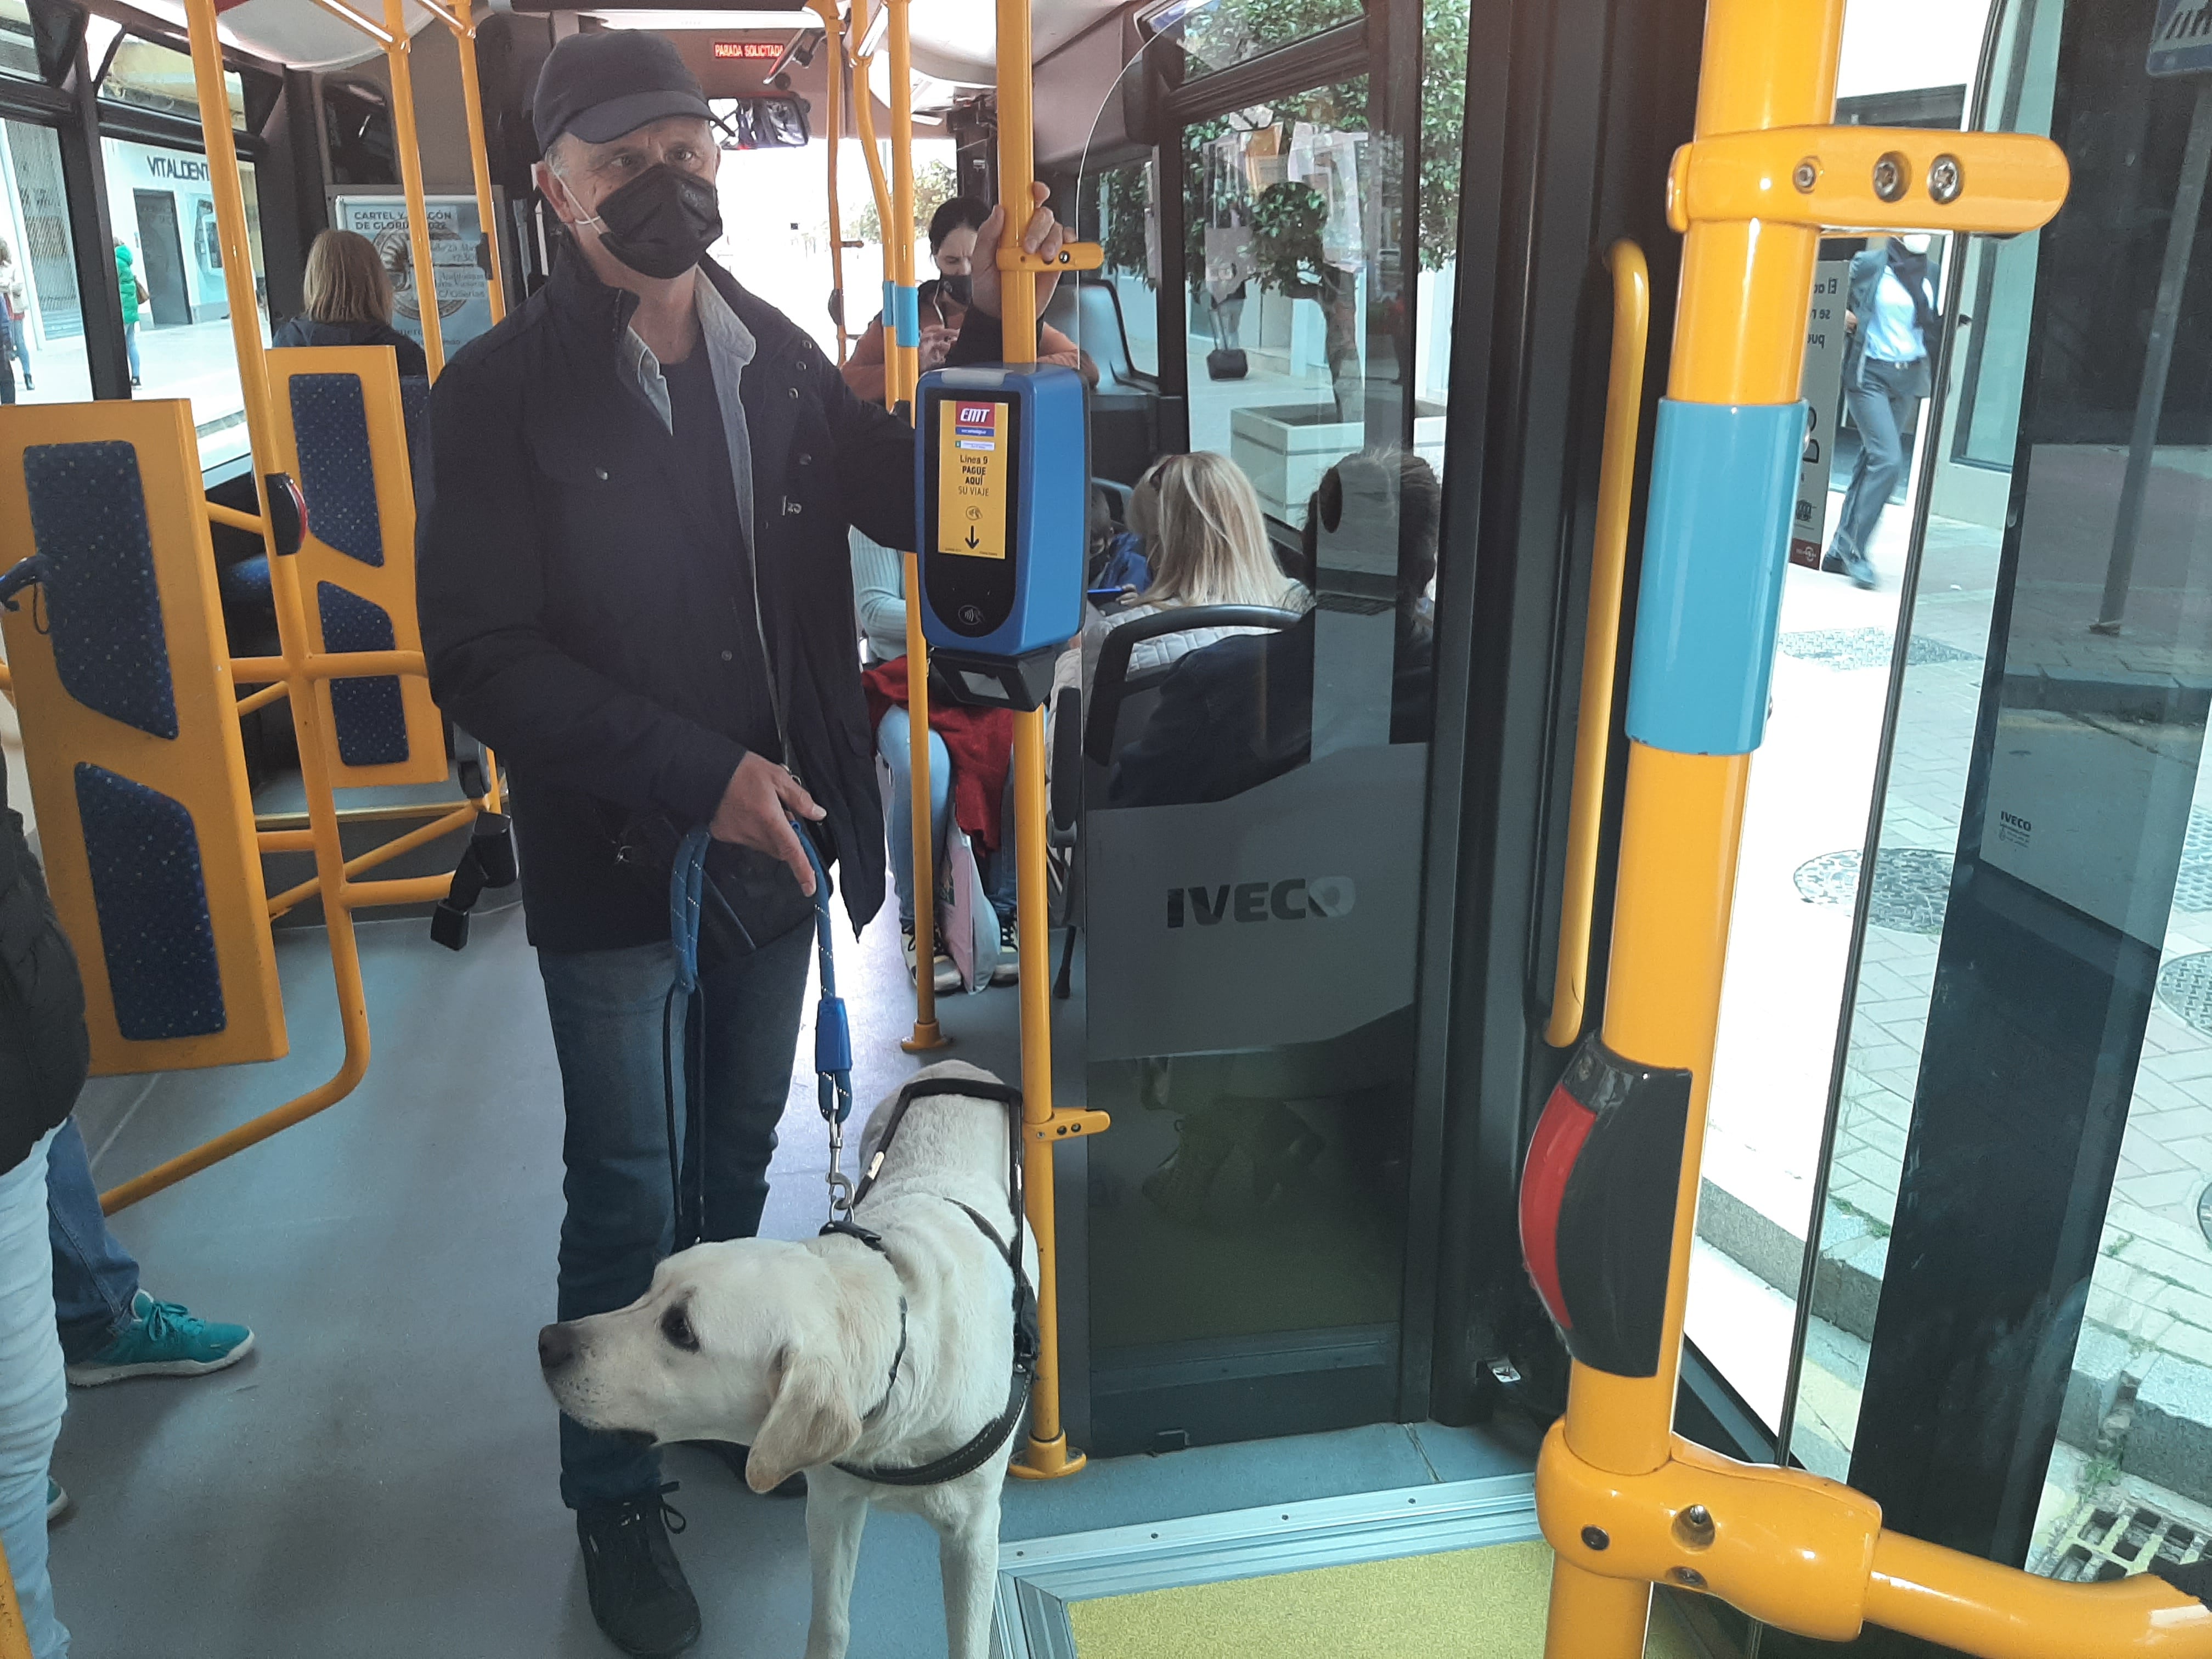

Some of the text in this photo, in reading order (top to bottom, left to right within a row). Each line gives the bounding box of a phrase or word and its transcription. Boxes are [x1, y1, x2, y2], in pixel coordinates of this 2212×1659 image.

[715, 44, 743, 57] PARADA
[354, 211, 394, 220] CARTEL
[356, 221, 370, 230] DE
[373, 222, 409, 230] GLORI
[960, 408, 990, 423] EMT
[983, 456, 988, 464] 9
[962, 466, 986, 476] PAGUE
[958, 486, 989, 496] SU VIAJE
[2000, 810, 2032, 832] IVECO
[1167, 876, 1356, 928] IVECO
